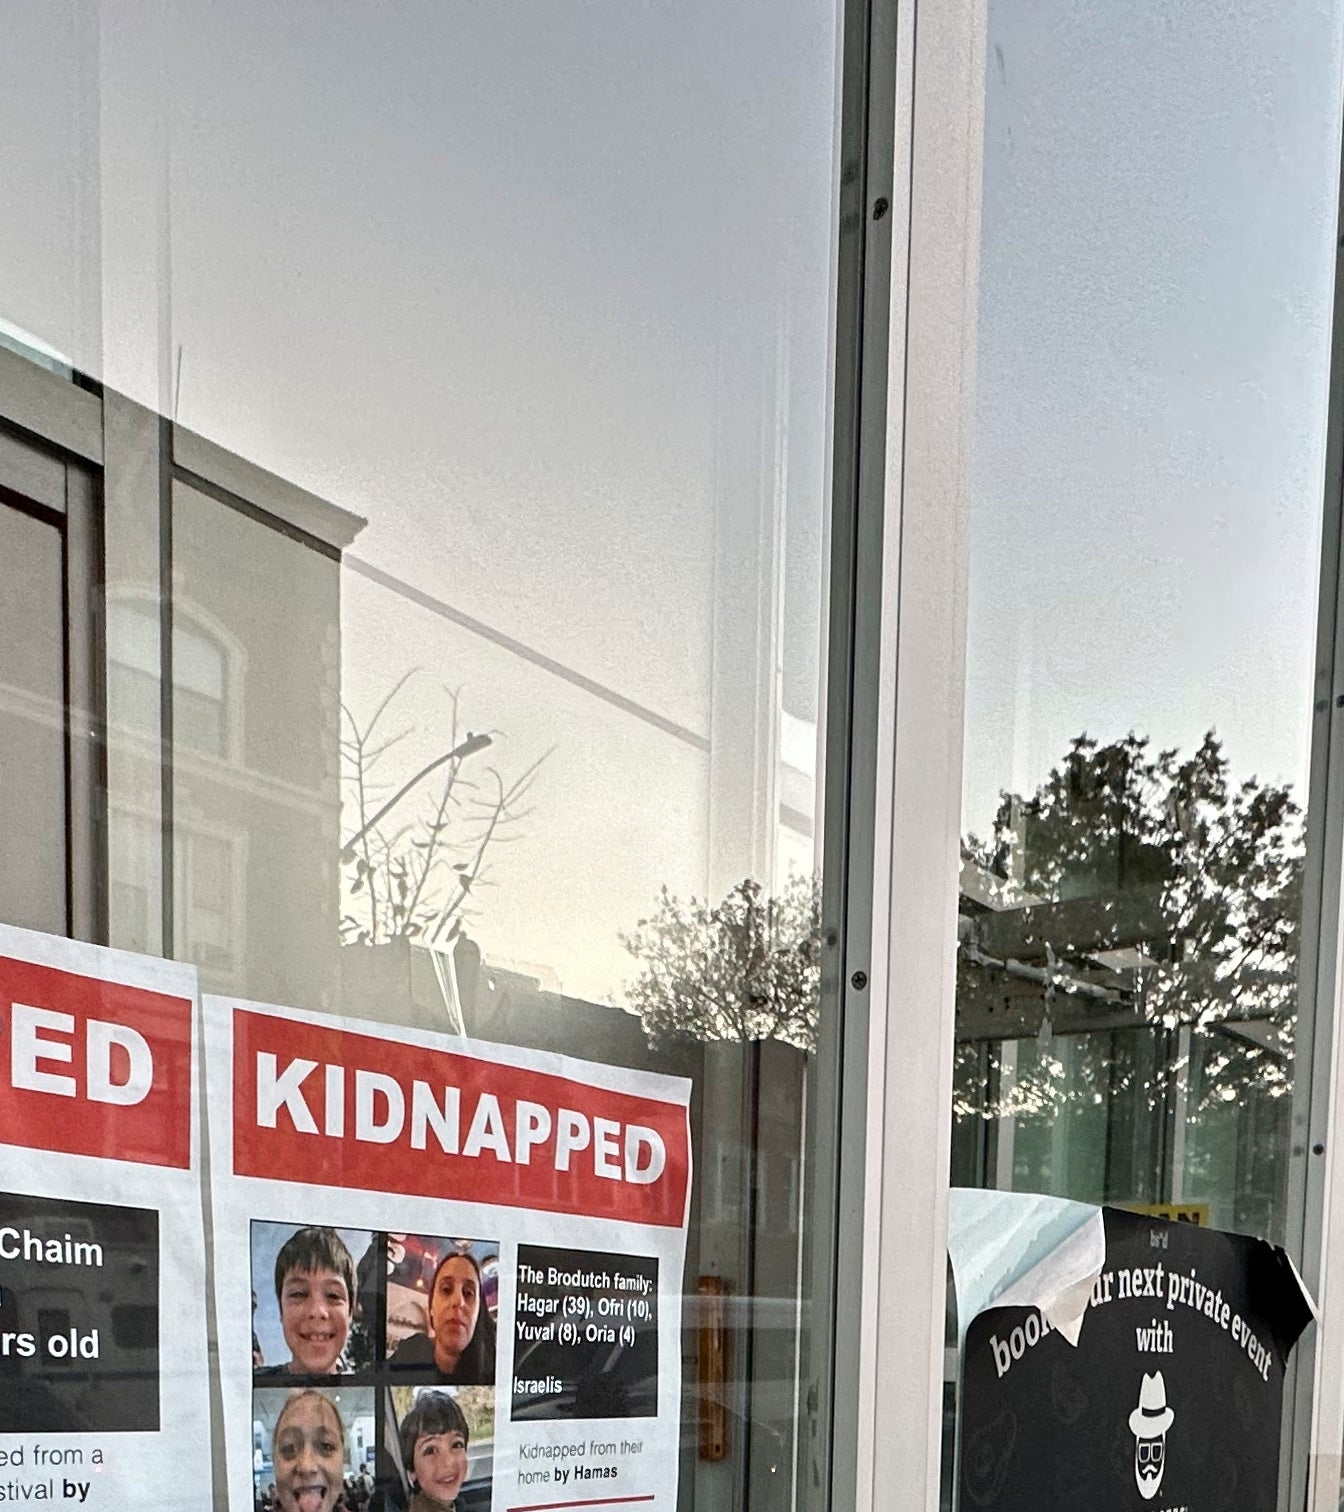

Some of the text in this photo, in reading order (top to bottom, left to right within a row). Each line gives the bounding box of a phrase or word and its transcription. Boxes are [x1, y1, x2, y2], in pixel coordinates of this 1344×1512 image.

[256, 1051, 667, 1185] KIDNAPPED
[518, 1265, 653, 1296] The Brodutch family:
[517, 1292, 653, 1322] Hagar (39), Ofri (10),
[516, 1321, 635, 1348] Yuval (8), Oria (4)
[1117, 1263, 1165, 1299] next
[1166, 1269, 1231, 1329] private
[1231, 1313, 1273, 1382] event
[1135, 1318, 1174, 1353] with
[48, 1328, 99, 1359] old
[513, 1376, 563, 1394] Israelis
[34, 1446, 84, 1466] from
[91, 1449, 104, 1465] a
[519, 1441, 586, 1461] Kidnapped
[590, 1440, 616, 1456] from
[518, 1465, 618, 1486] home by Hamas
[62, 1479, 91, 1502] by
